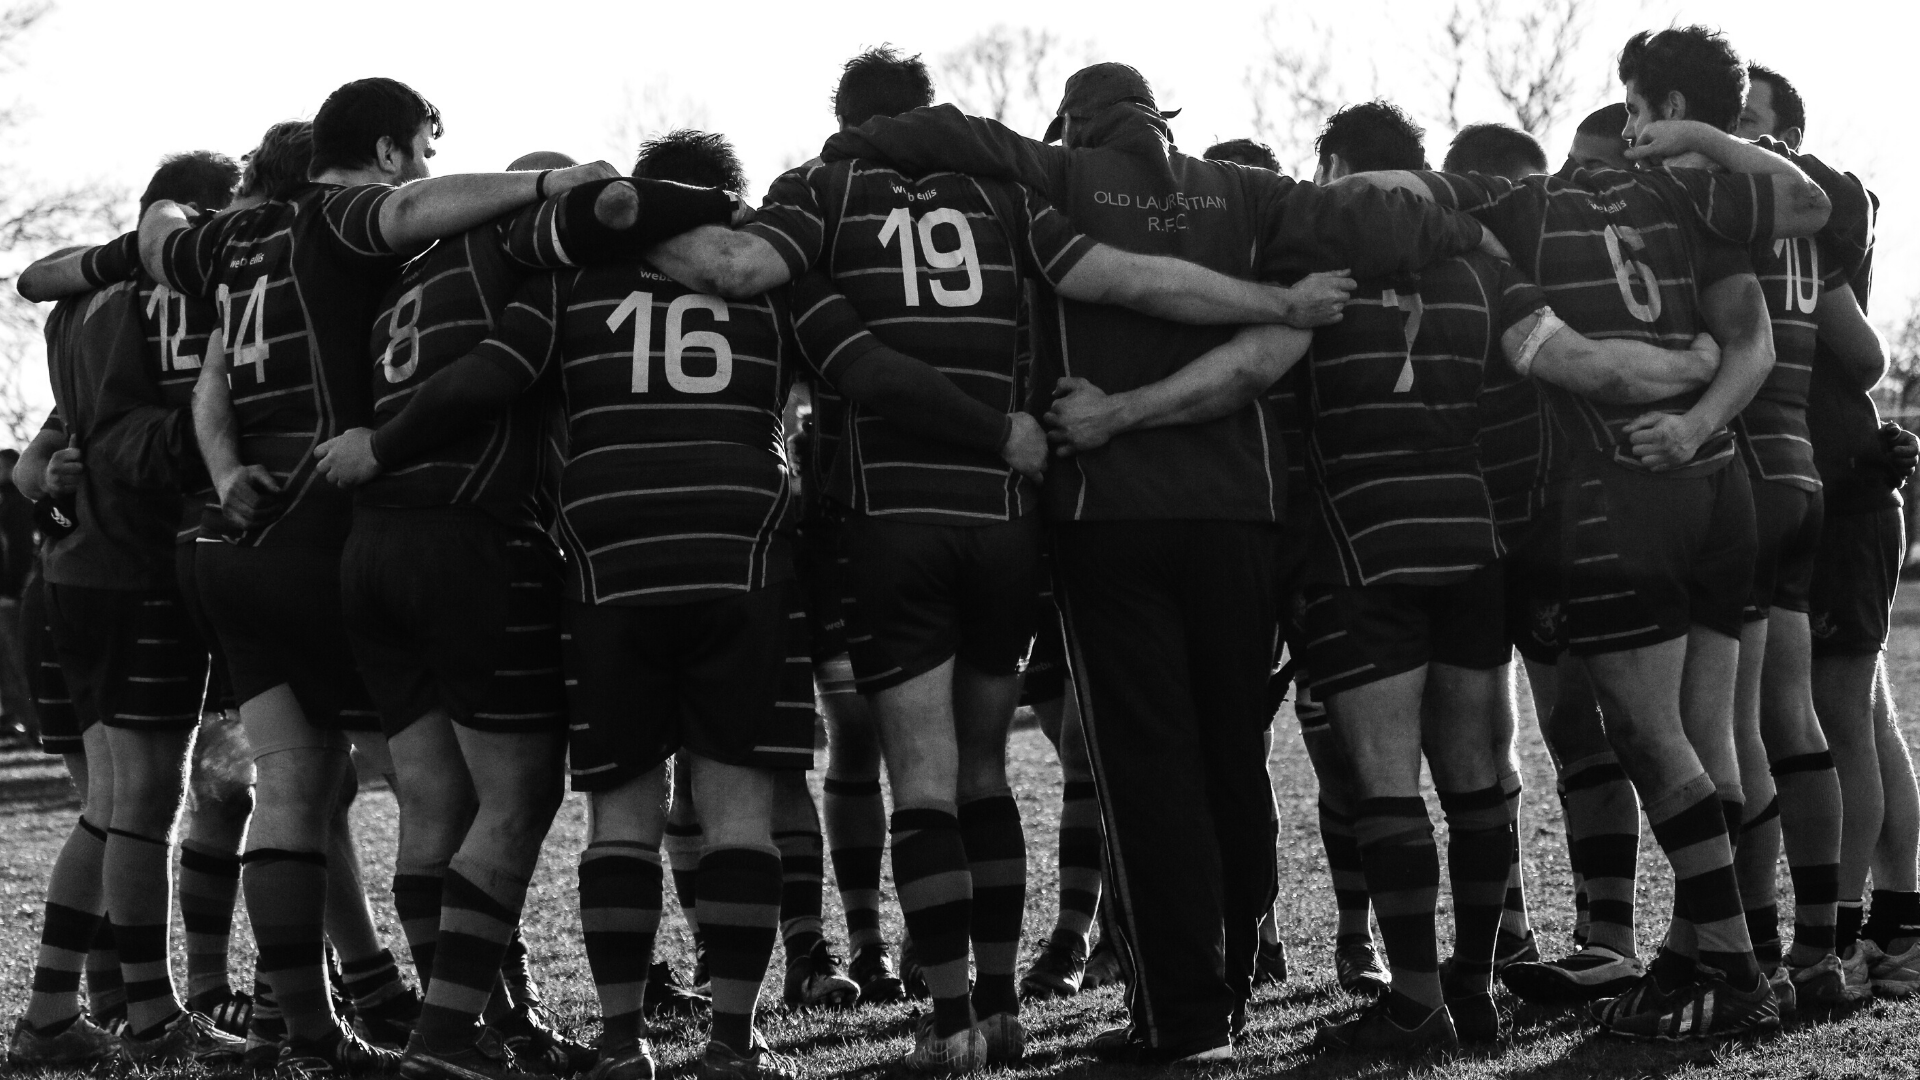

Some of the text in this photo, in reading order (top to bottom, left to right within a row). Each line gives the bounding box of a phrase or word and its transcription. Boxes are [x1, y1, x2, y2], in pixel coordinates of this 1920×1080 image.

[916, 188, 937, 201] ellis
[1093, 190, 1227, 212] OLD LAURENTIAN
[1148, 213, 1190, 233] R.F.C.
[877, 207, 983, 307] 19
[1604, 224, 1662, 322] 6
[1772, 237, 1819, 314] 10
[145, 283, 202, 372] 12
[382, 283, 423, 384] 8
[605, 290, 733, 394] 16
[1382, 288, 1424, 393] 7
